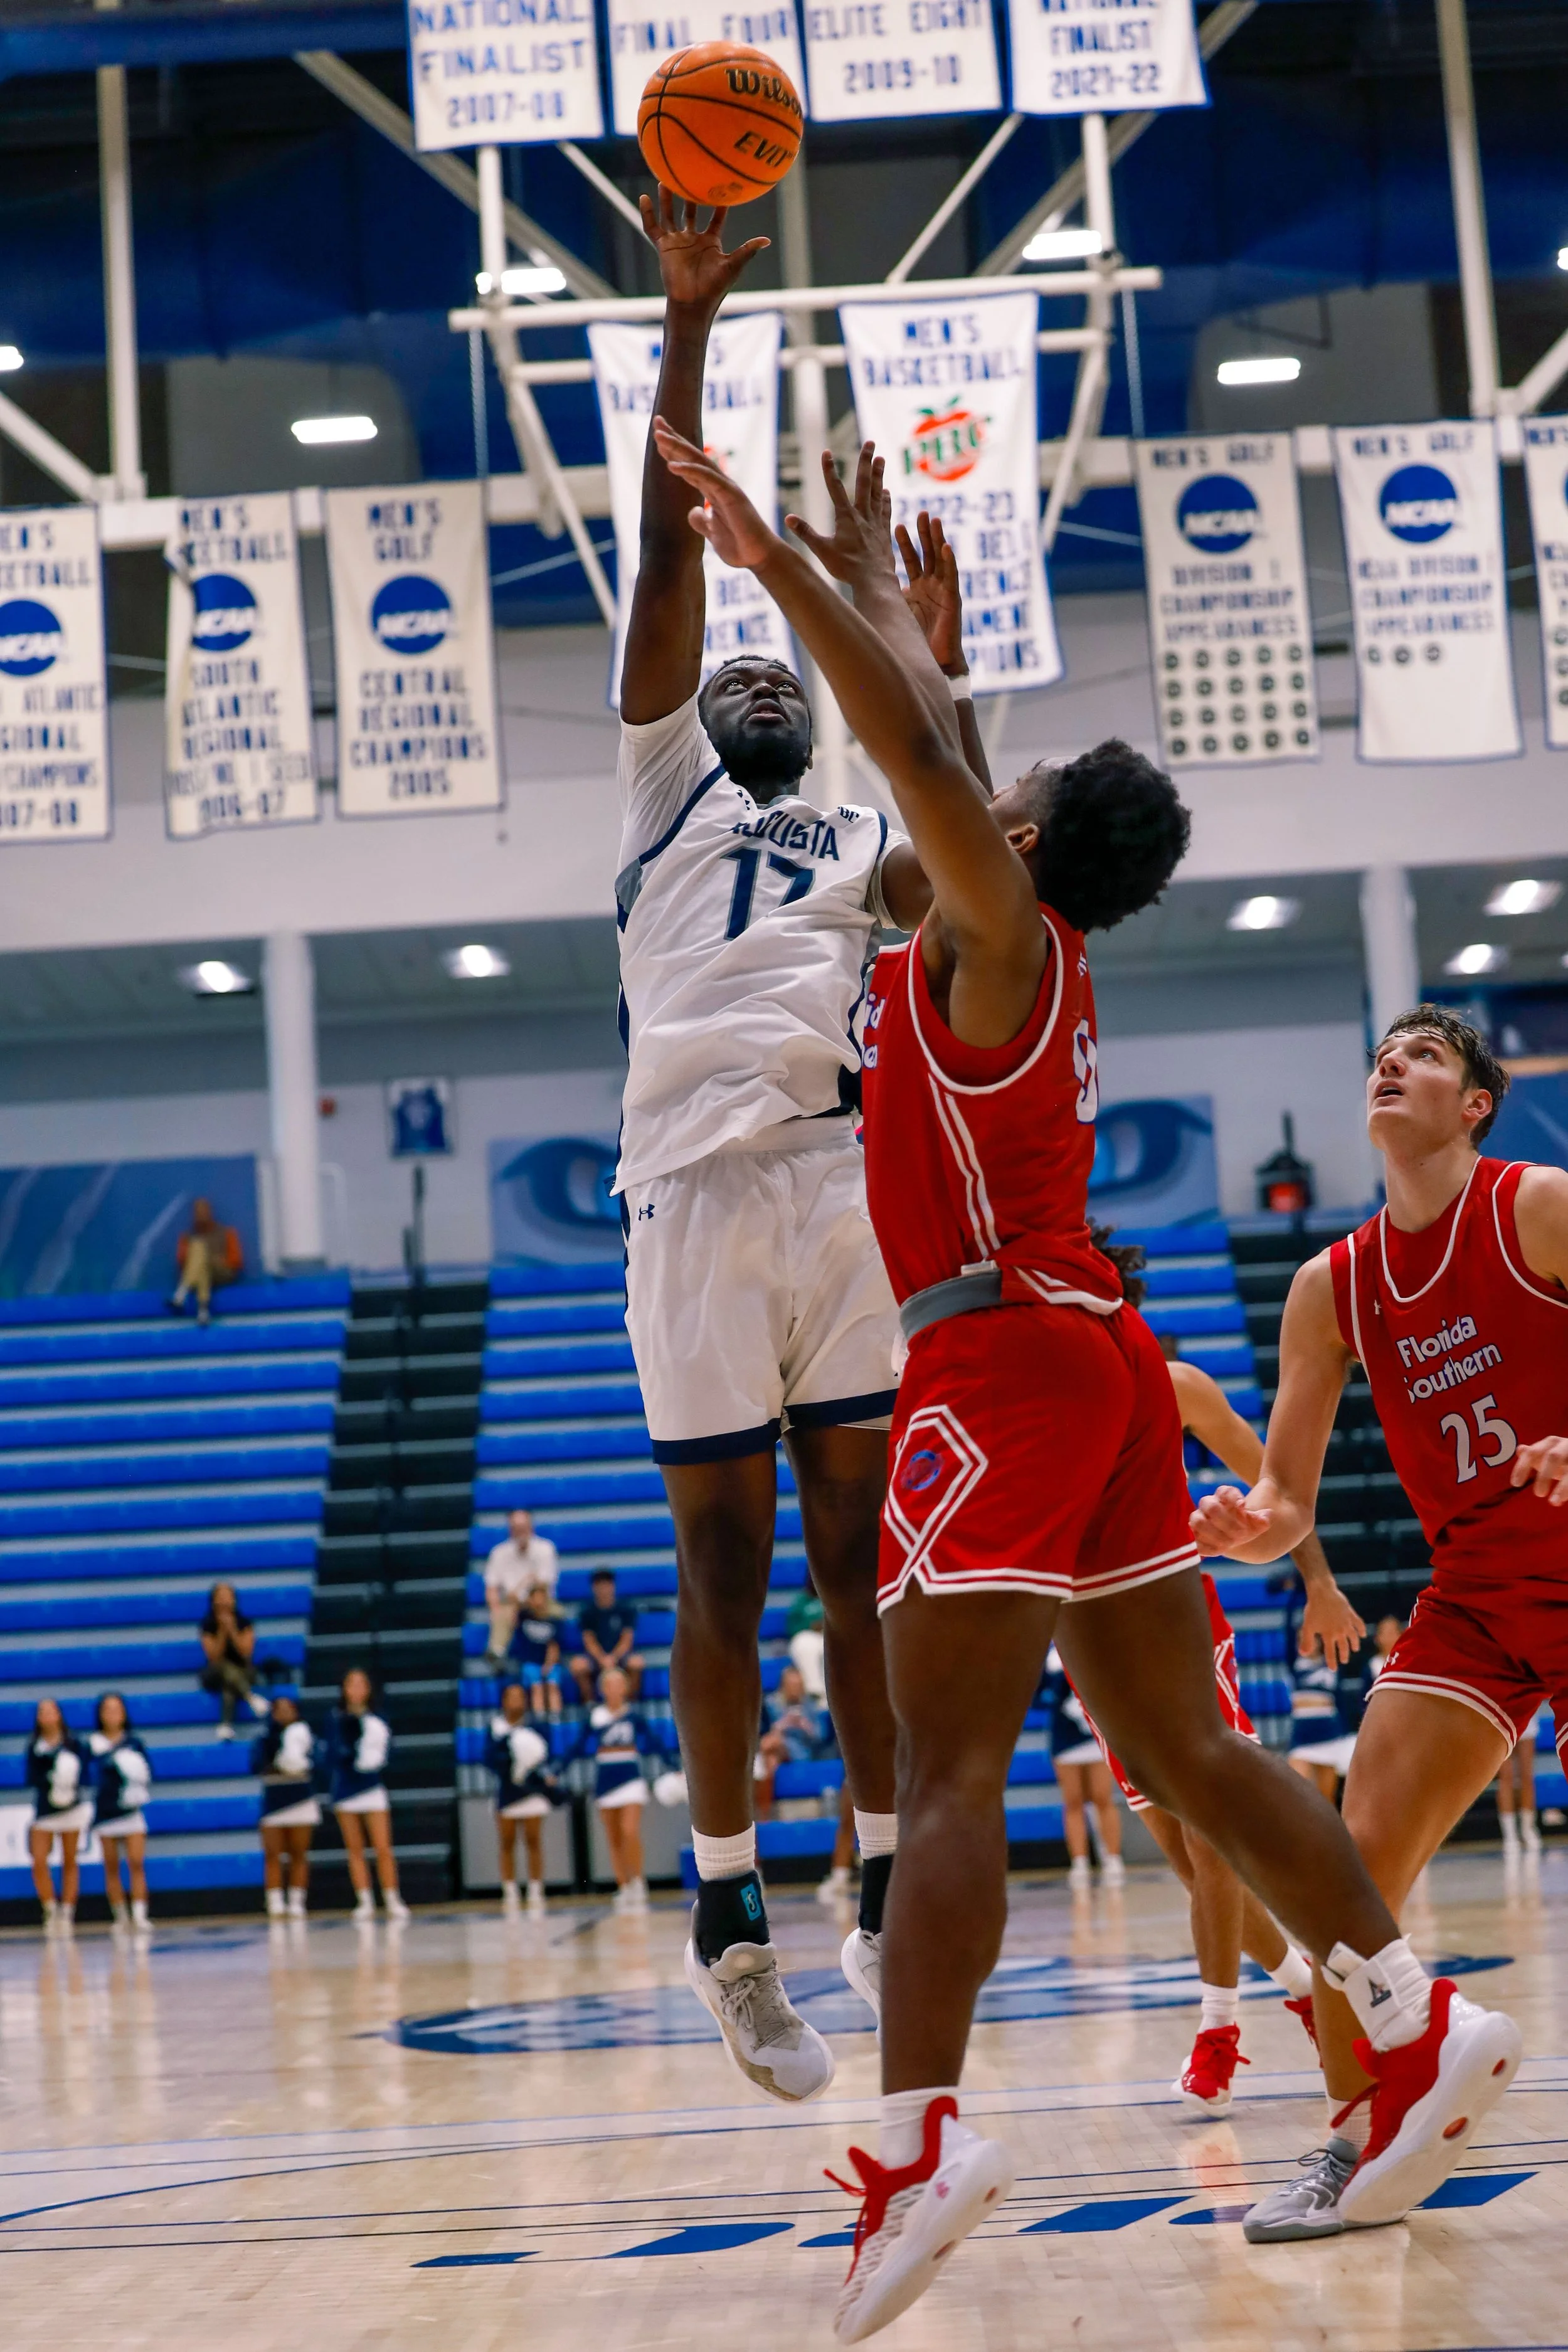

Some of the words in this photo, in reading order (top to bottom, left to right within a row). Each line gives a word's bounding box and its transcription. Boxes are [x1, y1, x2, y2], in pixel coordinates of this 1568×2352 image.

[610, 16, 695, 52] FINAL
[805, 5, 885, 41] ELITE
[909, 0, 982, 33] EIGHT
[1050, 20, 1152, 55] FINALIST
[419, 39, 585, 83] FINALIST
[1051, 61, 1160, 98] 2021-22
[902, 314, 980, 347] MEN'S
[862, 349, 1024, 387] BASKETBALL
[607, 378, 765, 414] BASBALL
[1153, 444, 1209, 467] MEN'S
[1353, 435, 1408, 457] MEN'S
[368, 499, 441, 529] MEN'S
[0, 522, 54, 552] EN'S
[375, 533, 433, 563] GOLF
[1173, 563, 1252, 586] DIVISION
[1409, 554, 1478, 577] DIVISION
[1160, 588, 1294, 615] CHAMPIONSHIP
[1357, 580, 1491, 608] CHAMPIONSHIP
[1165, 615, 1296, 640] APPEARANCES
[1361, 610, 1496, 637] APPEARANCES
[192, 660, 258, 688] SOUTH
[360, 667, 467, 698] CENTRAL
[182, 692, 280, 726] ATLANTIC
[360, 702, 474, 732] REGIONAL
[0, 723, 80, 751] GIONAL
[183, 728, 282, 760] REGIONAL
[350, 734, 485, 766] CHAMPIONS
[719, 845, 815, 941] 17
[1396, 1315, 1478, 1369] Florida
[1440, 1393, 1517, 1484] 25
